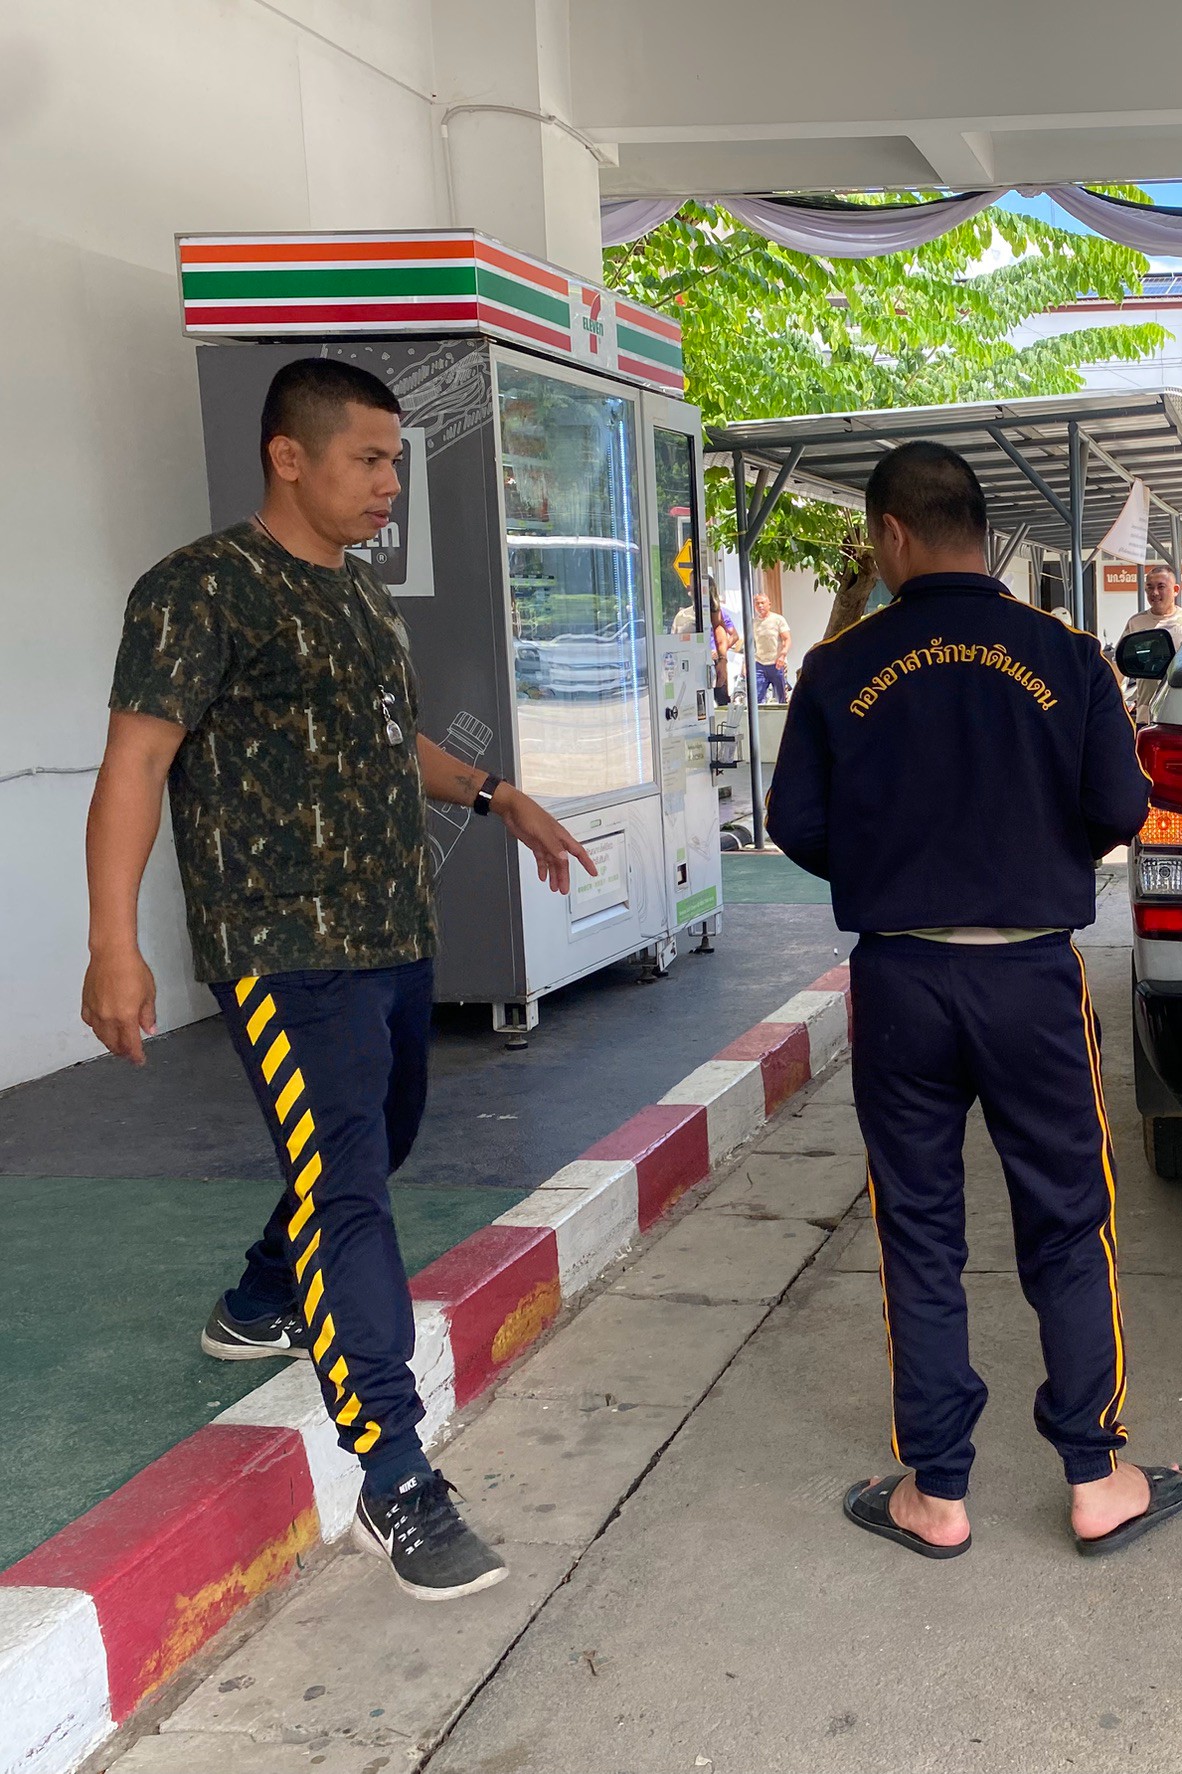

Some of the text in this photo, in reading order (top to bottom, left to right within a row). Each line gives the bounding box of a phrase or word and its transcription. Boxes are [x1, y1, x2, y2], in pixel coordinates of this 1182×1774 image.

[849, 637, 1059, 718] กองอาสารักษาดินแดน
[399, 1476, 418, 1494] NIKE
